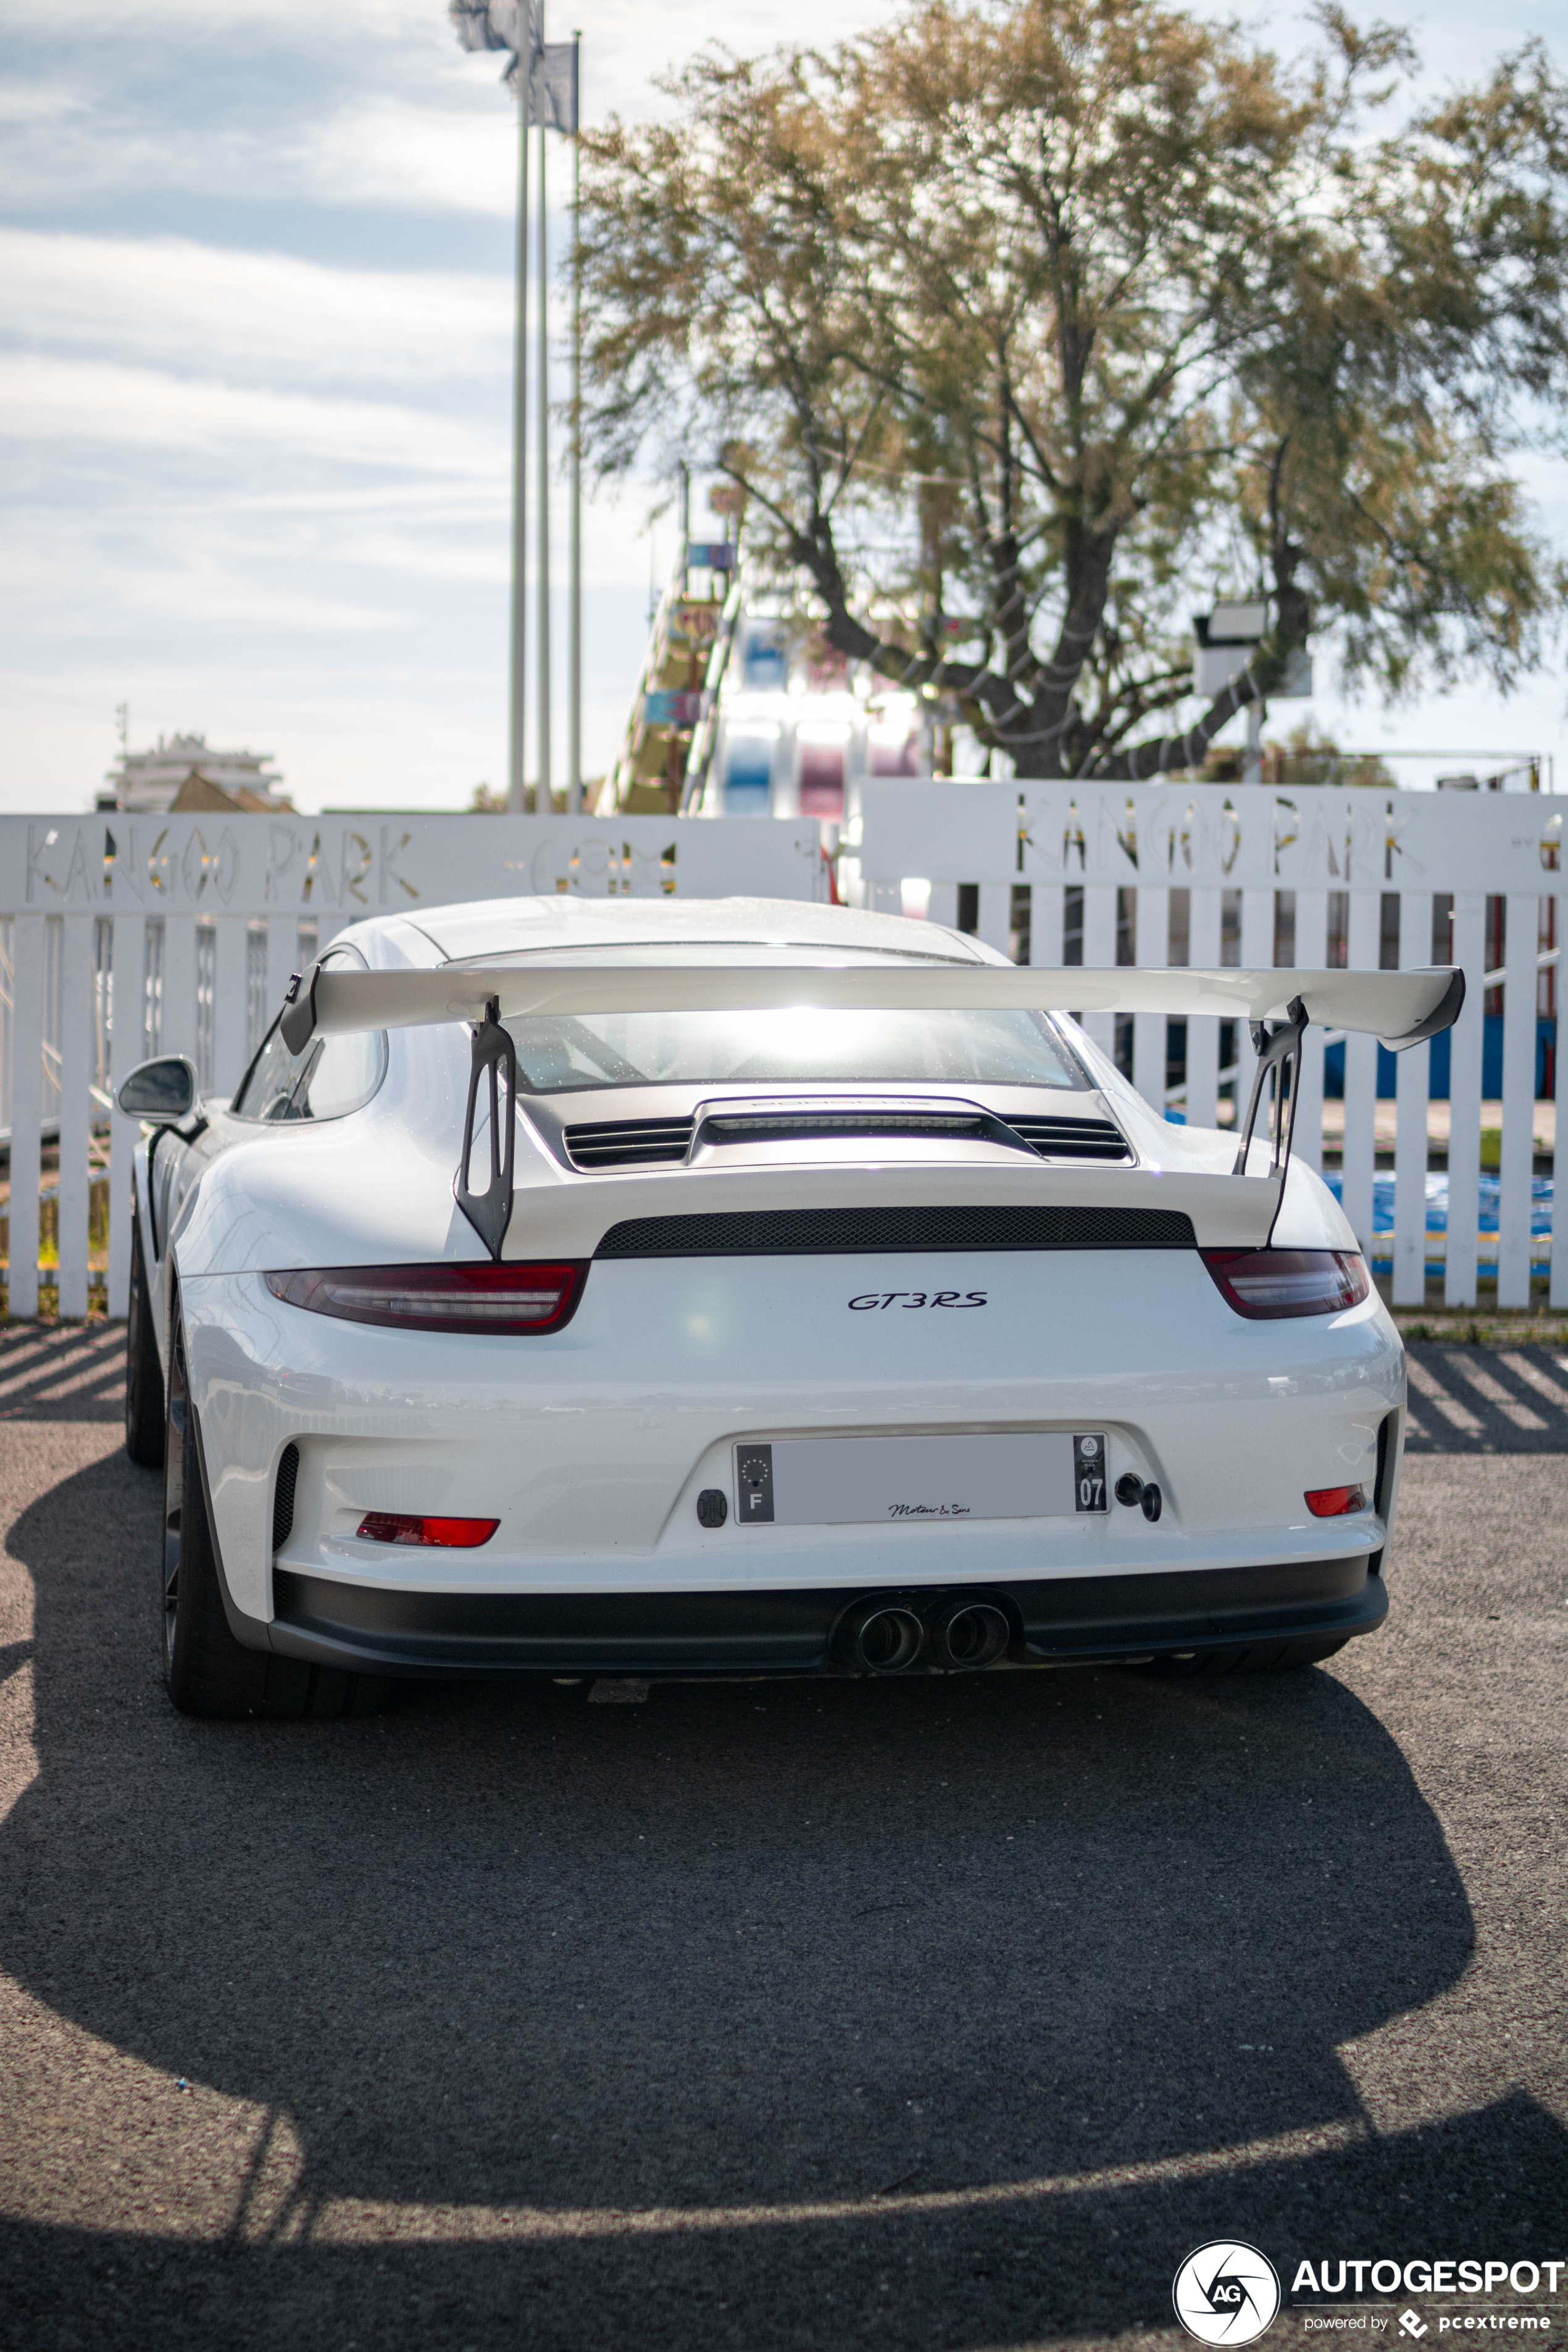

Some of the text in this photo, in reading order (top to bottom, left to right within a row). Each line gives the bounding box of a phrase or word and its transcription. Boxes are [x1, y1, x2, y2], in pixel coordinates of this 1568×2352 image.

[1016, 793, 1242, 878] KANGOO
[1272, 794, 1428, 882] PARK
[25, 822, 240, 906] KANGOO
[265, 822, 420, 908] PARK
[750, 1493, 762, 1509] F
[1080, 1478, 1103, 1506] 07
[939, 1505, 949, 1514] &
